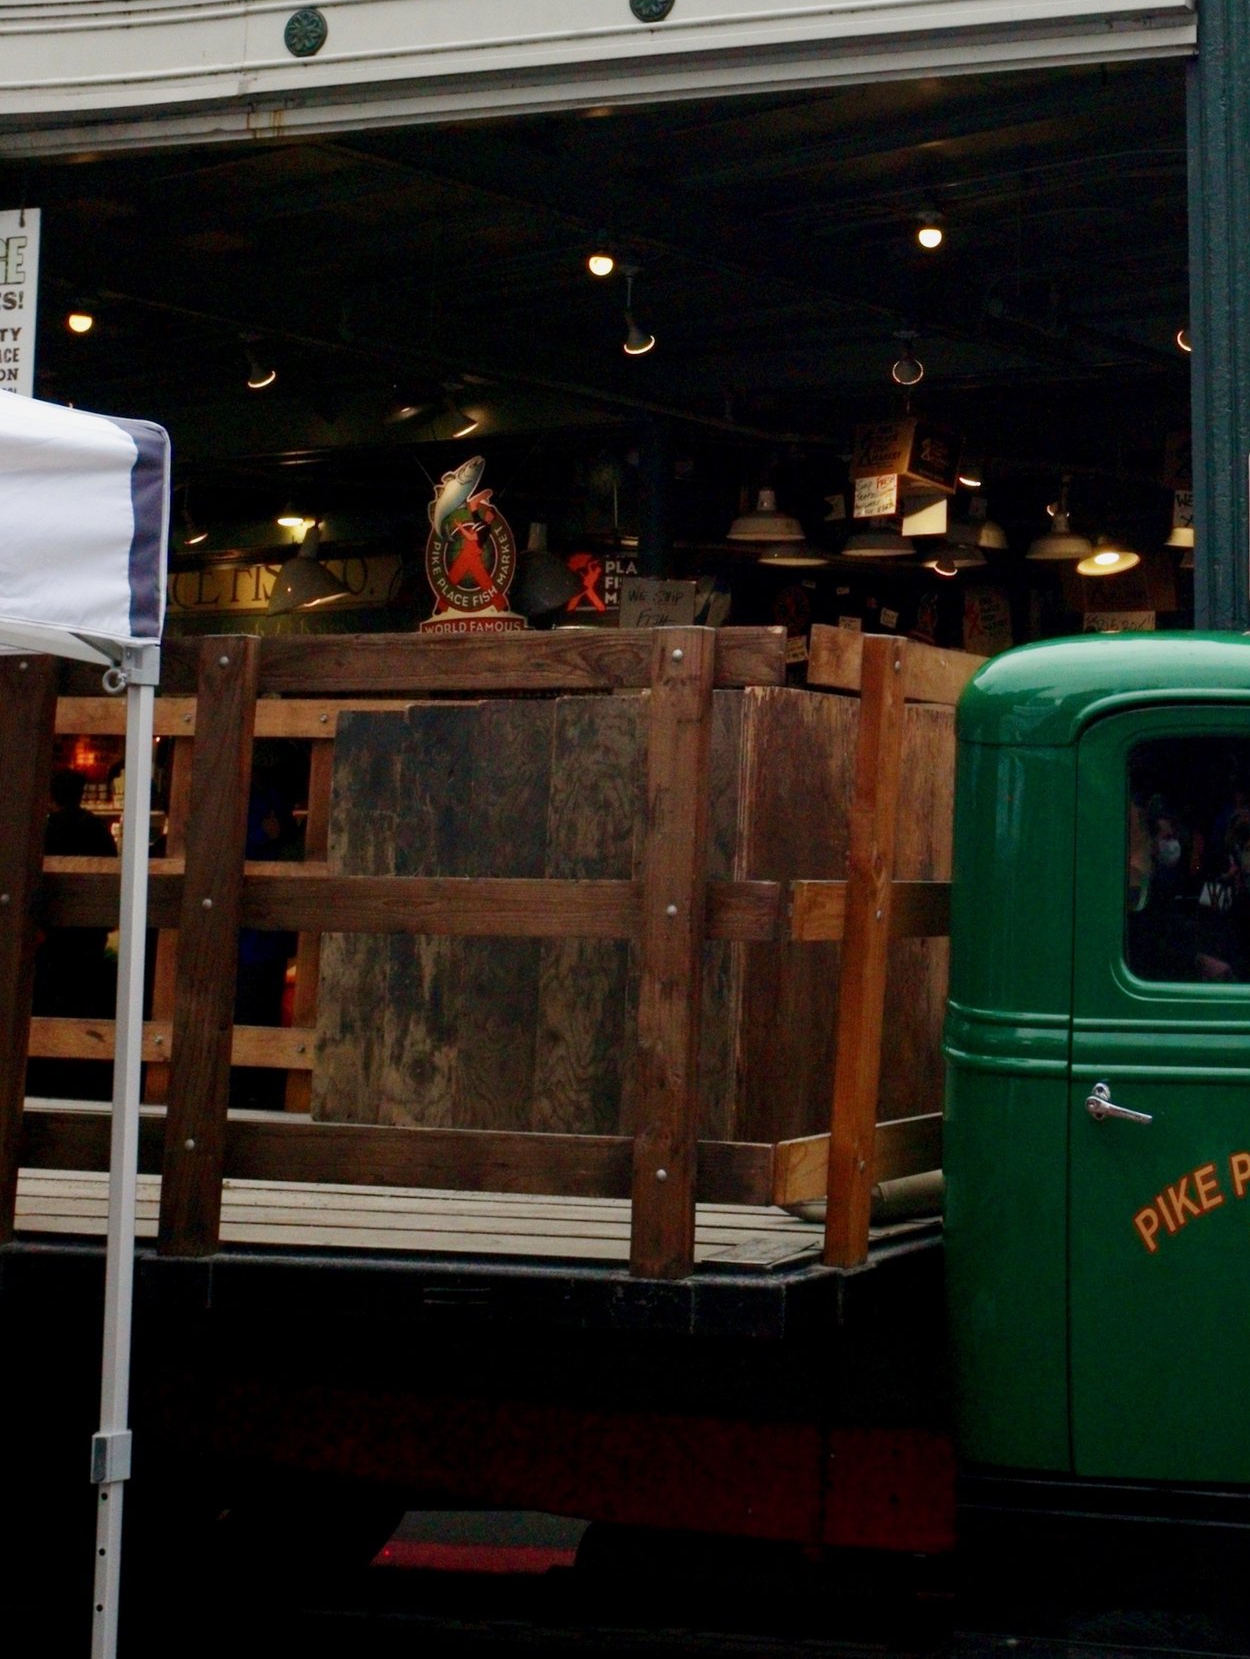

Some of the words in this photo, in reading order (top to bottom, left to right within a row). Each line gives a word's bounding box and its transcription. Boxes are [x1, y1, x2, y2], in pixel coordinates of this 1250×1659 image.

[0, 290, 24, 311] S!
[431, 540, 442, 579] PIKE
[437, 578, 469, 607] PLACE
[472, 585, 498, 607] FISH
[496, 525, 512, 586] MARKET
[604, 576, 622, 590] FI
[424, 622, 466, 634] WORLD
[469, 620, 521, 633] FAMOUS
[1132, 1163, 1224, 1254] PIKE
